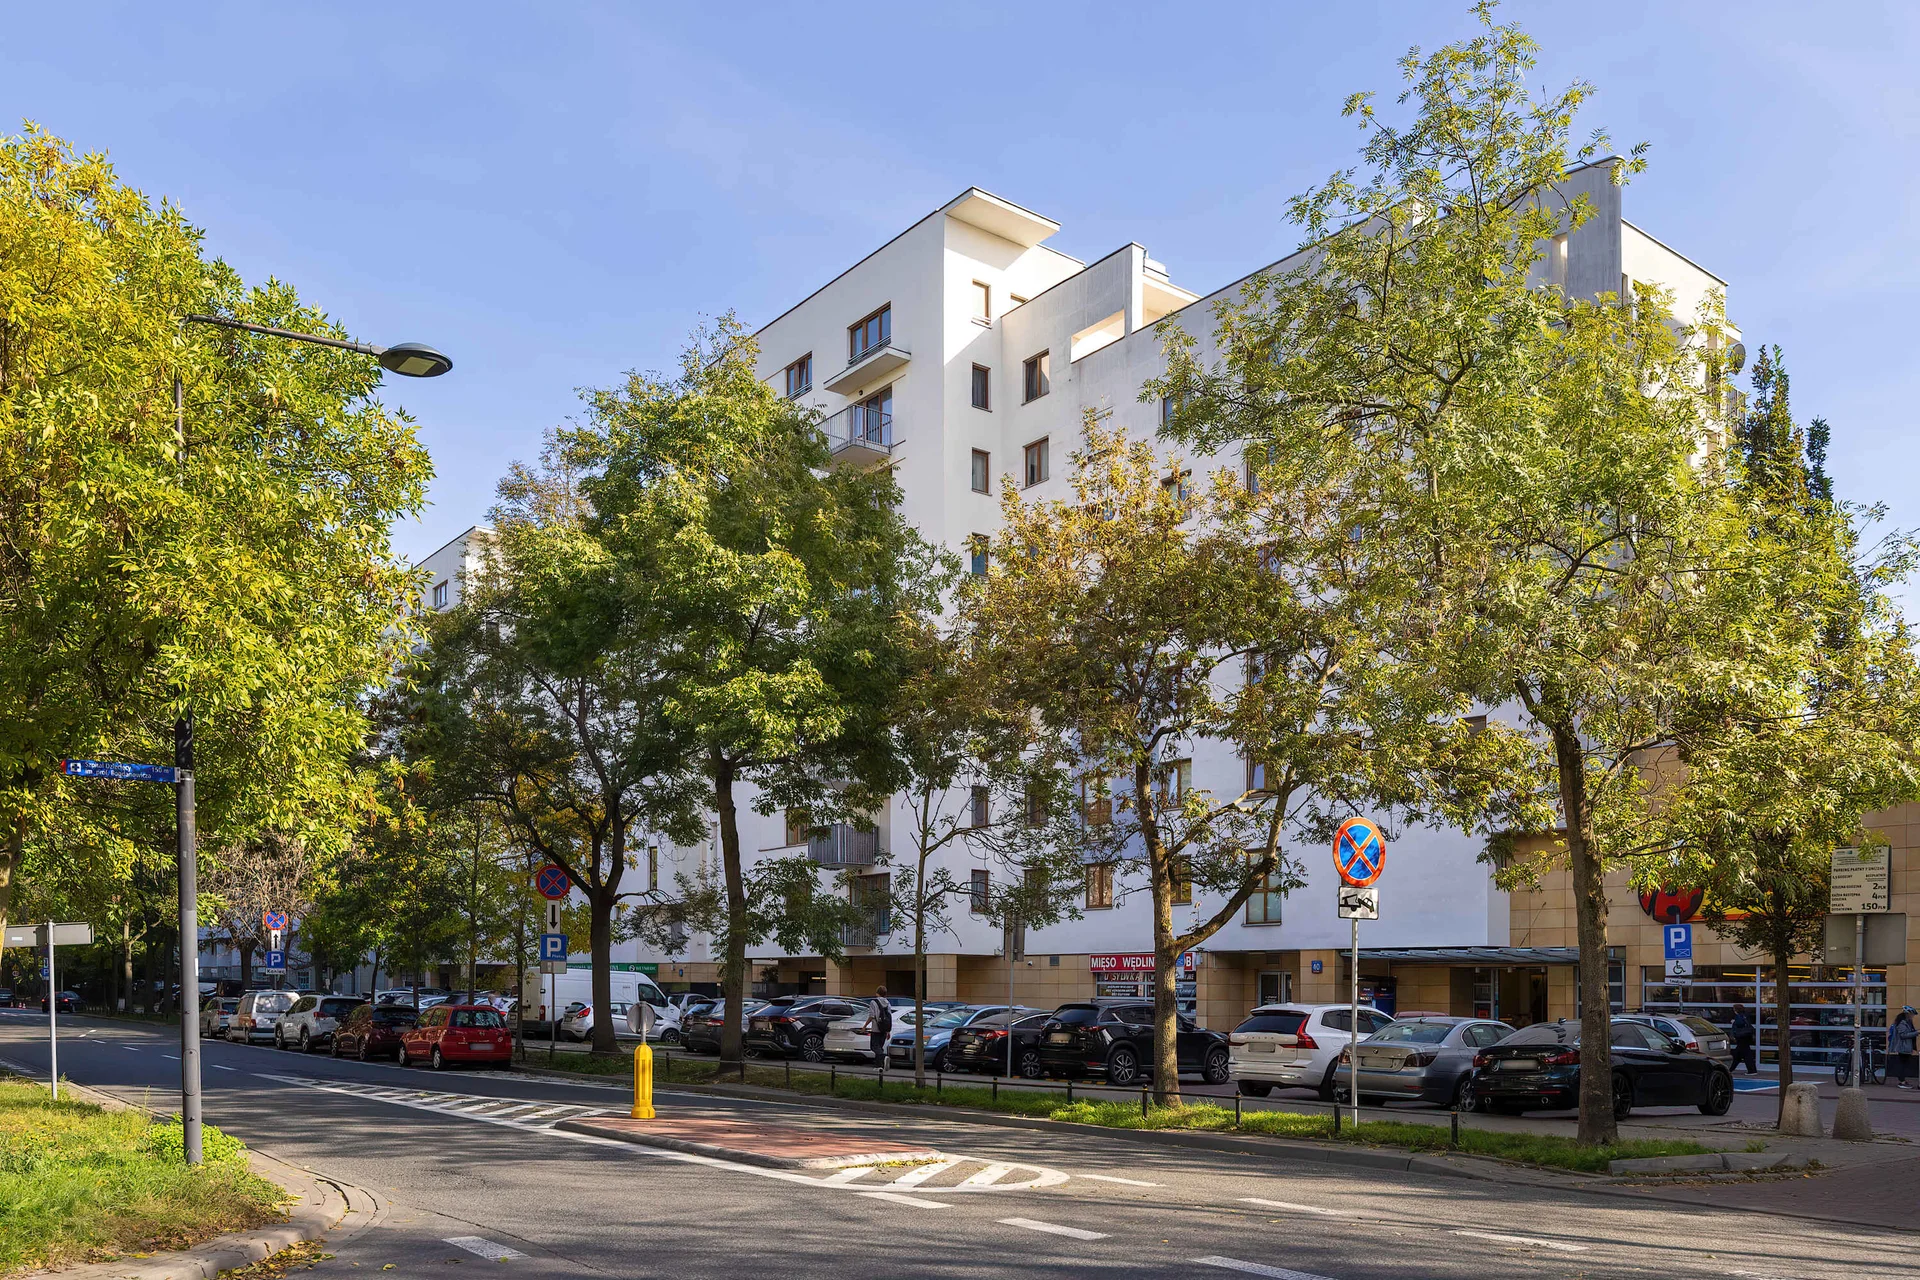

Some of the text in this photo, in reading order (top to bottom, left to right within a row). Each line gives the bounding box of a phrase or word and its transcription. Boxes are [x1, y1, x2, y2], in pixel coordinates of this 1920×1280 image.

[547, 937, 561, 957] P
[1670, 928, 1685, 949] P
[271, 953, 281, 966] P
[1091, 956, 1155, 970] MIĘSO WĘDLIN
